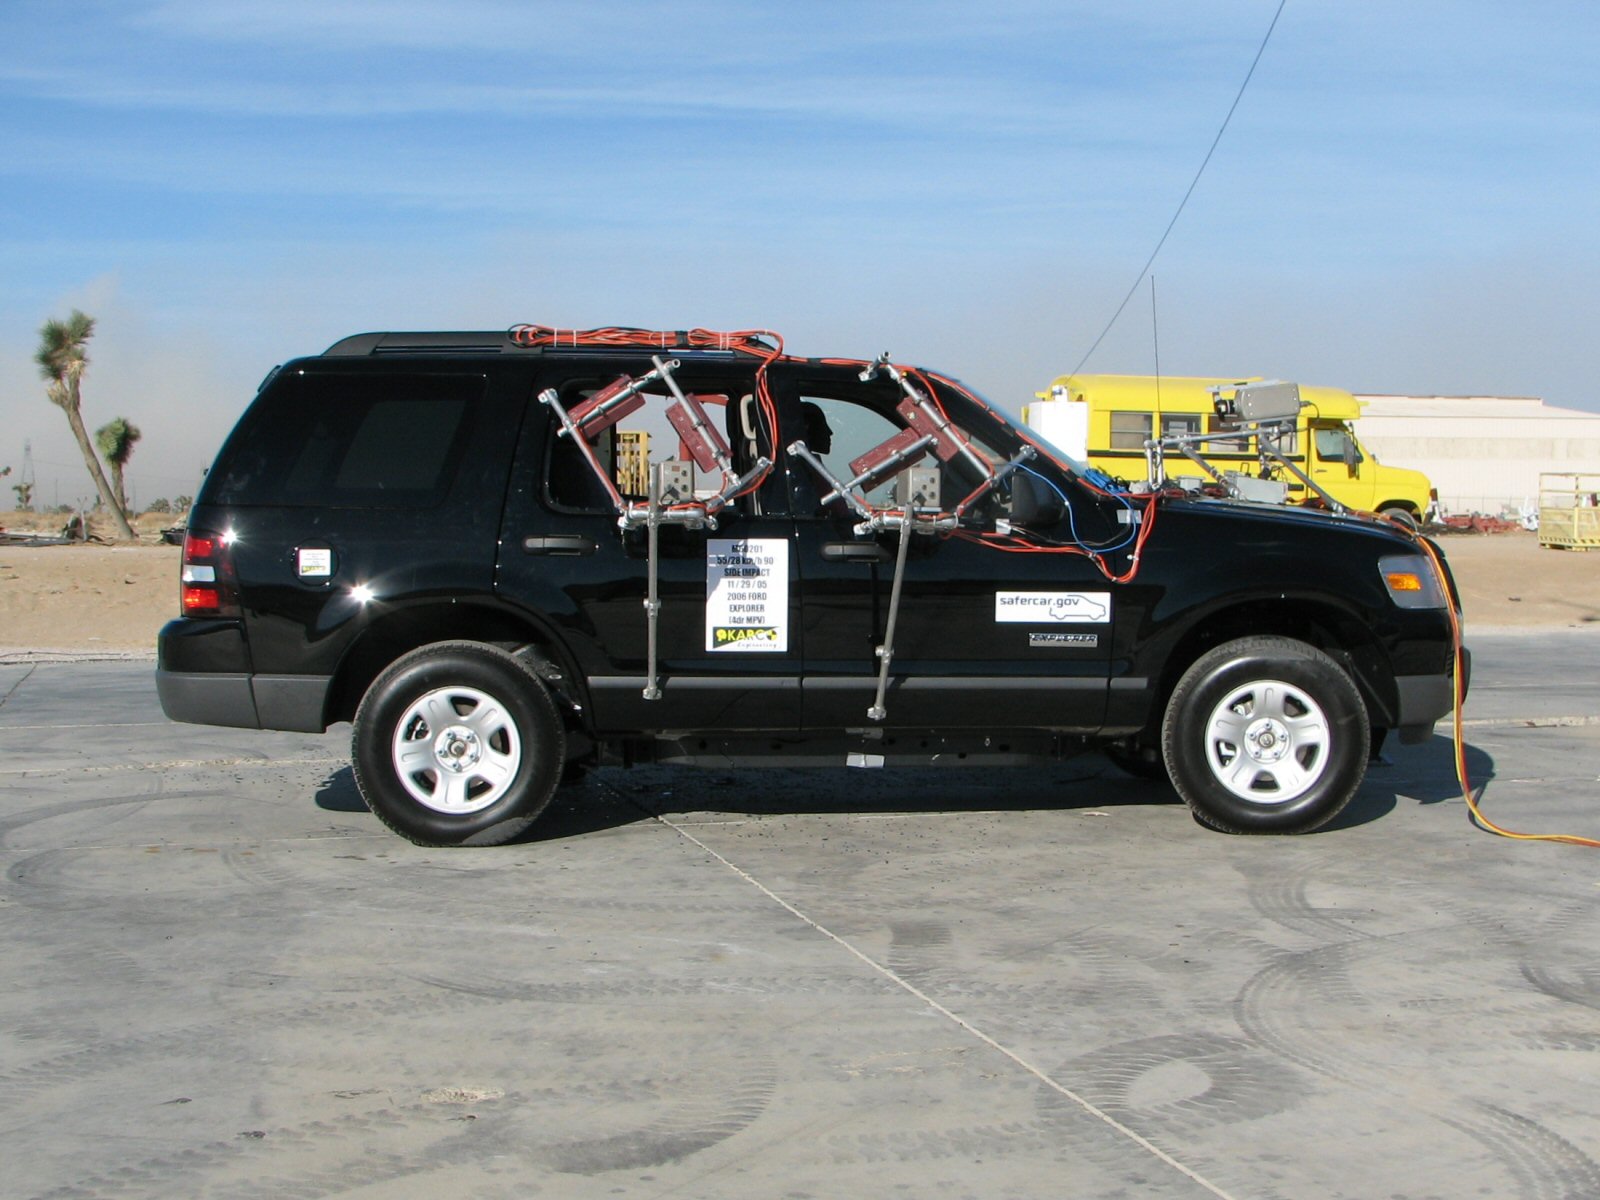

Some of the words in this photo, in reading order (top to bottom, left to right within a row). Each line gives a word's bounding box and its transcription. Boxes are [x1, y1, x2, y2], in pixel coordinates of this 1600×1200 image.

[717, 556, 741, 565] 55/28
[763, 556, 774, 565] 90
[724, 568, 741, 577] SIDE
[742, 568, 770, 577] IMPACT
[727, 592, 747, 601] 2006
[748, 592, 767, 601] FORD
[999, 595, 1080, 608] safercar.gov
[729, 604, 765, 613] EXPLORER
[729, 616, 744, 625] (4dr
[746, 616, 766, 625] MPV)
[1031, 634, 1096, 642] EXPLORER
